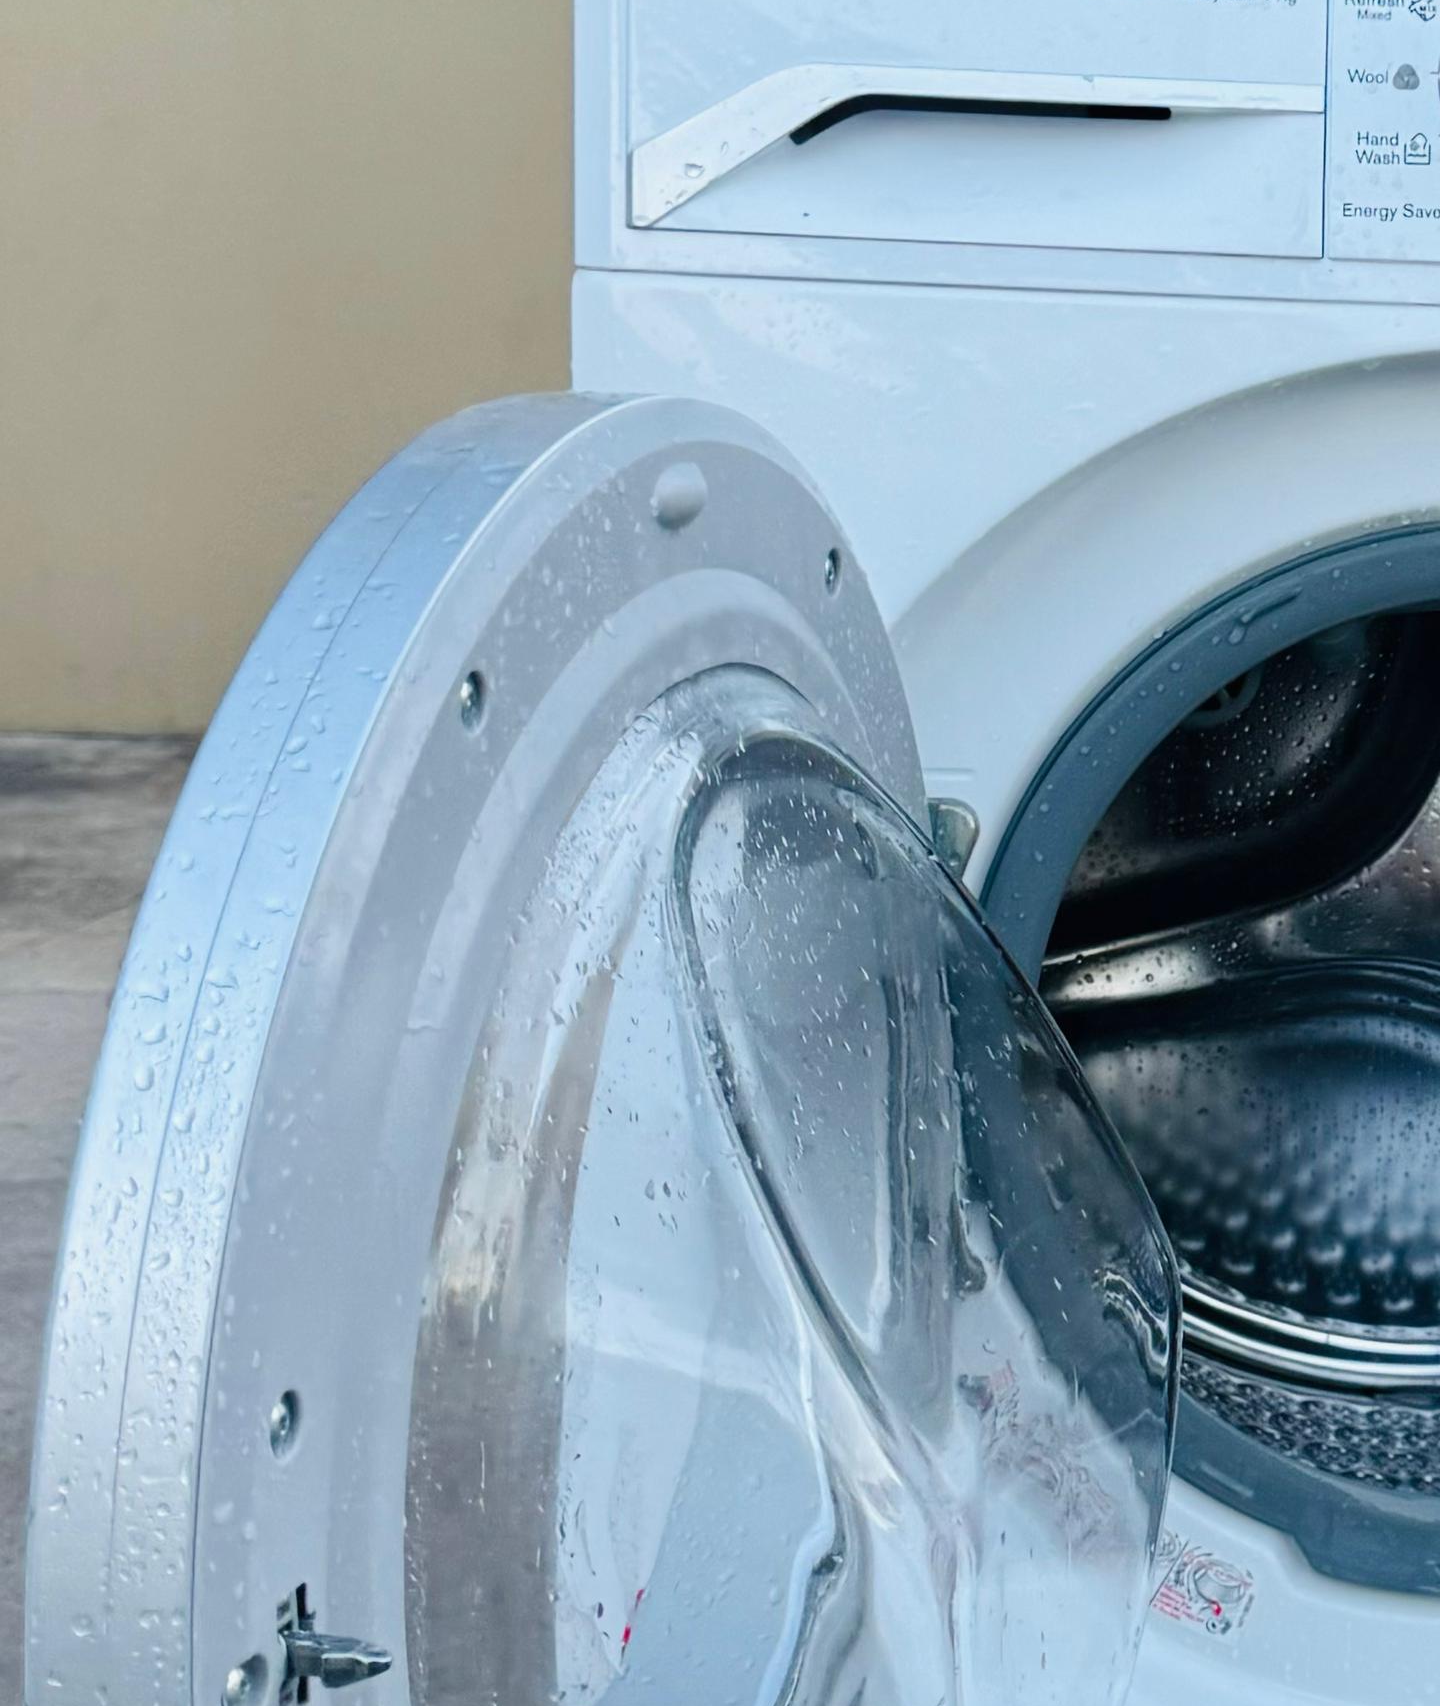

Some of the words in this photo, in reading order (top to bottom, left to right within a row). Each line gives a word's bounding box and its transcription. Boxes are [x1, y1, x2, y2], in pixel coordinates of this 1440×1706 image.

[1356, 9, 1393, 21] Mixed
[1346, 68, 1389, 85] Wool
[1356, 130, 1400, 147] Hand
[1355, 149, 1401, 165] Wash
[1342, 203, 1398, 222] Energy
